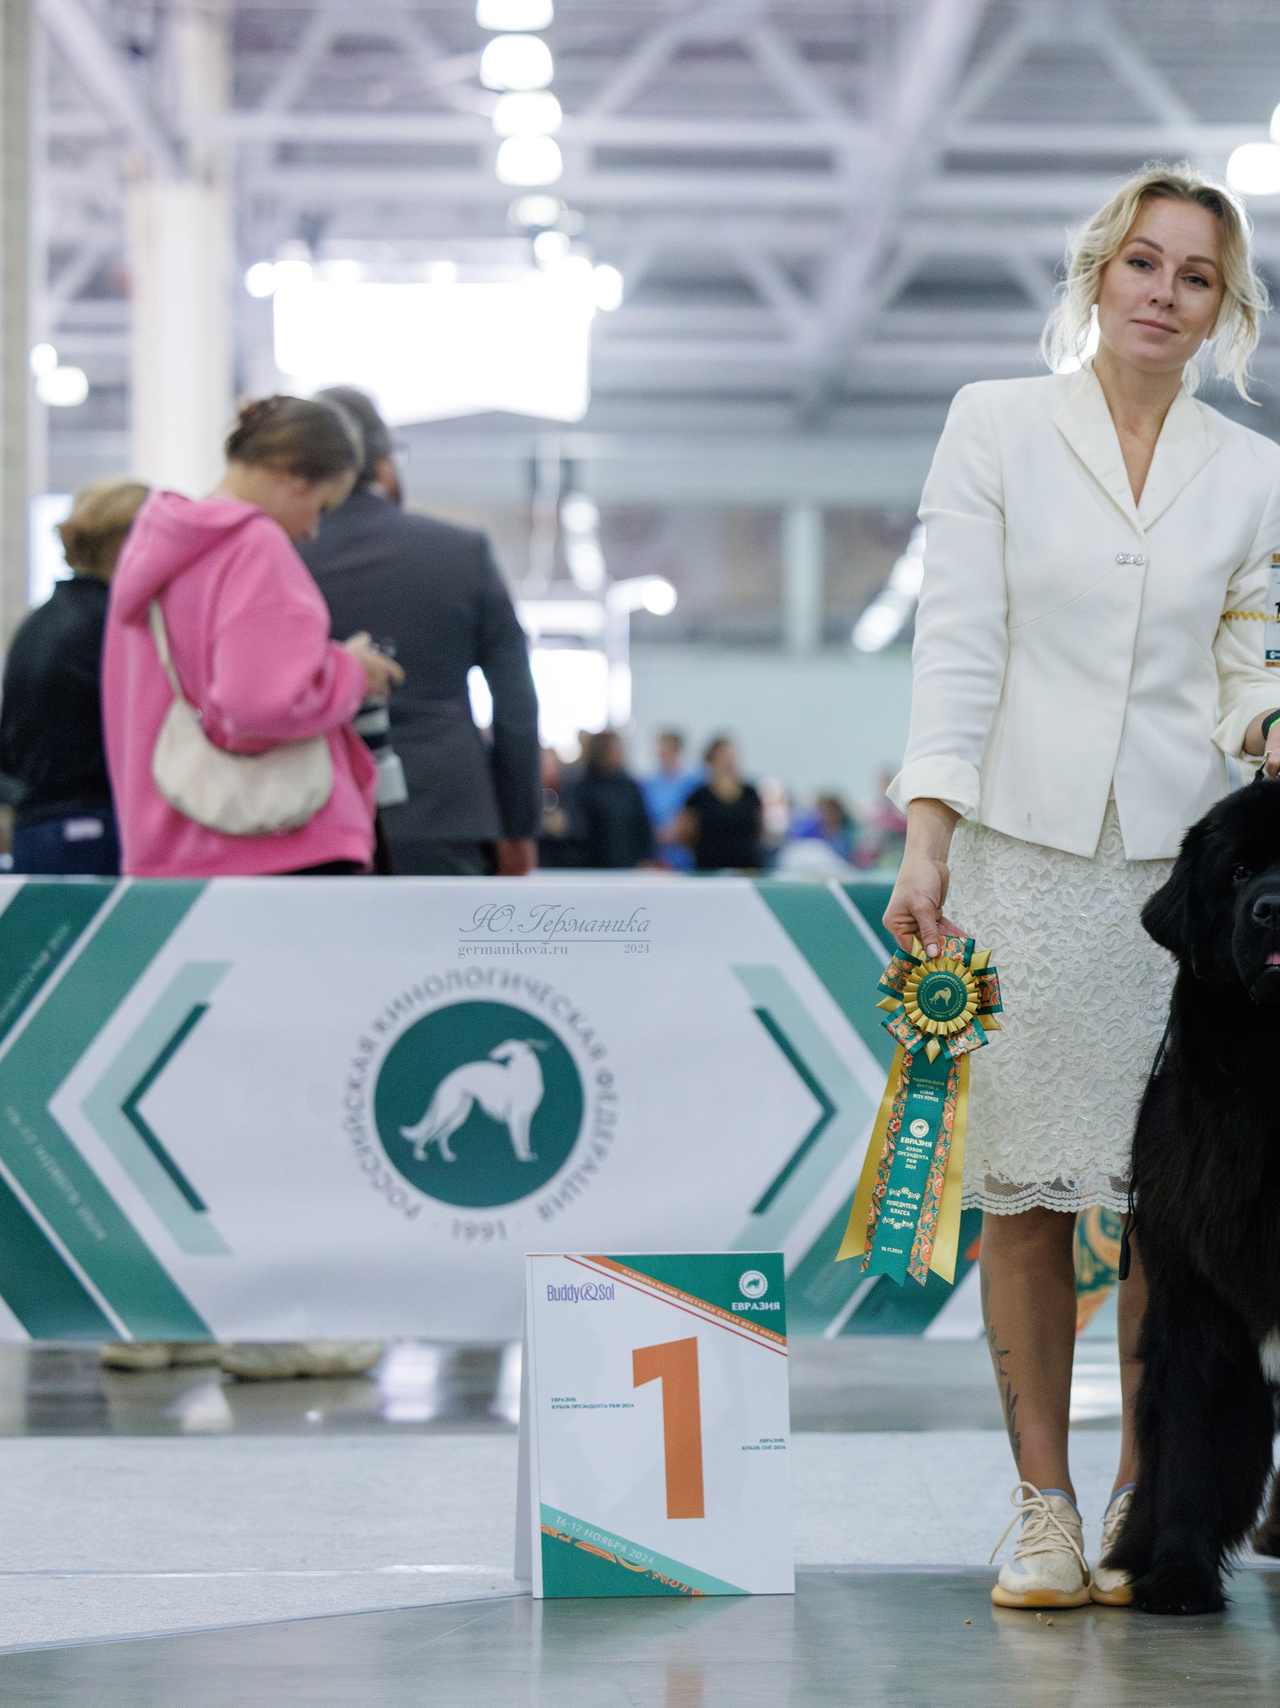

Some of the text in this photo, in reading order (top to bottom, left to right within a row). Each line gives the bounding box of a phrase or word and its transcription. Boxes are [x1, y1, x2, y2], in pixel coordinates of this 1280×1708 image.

[900, 1136, 933, 1148] ЕВРАЗИЯ
[897, 1150, 929, 1161] ПРЕЗИДЕНТА
[886, 1199, 918, 1210] ПОБЕДИТЕЛЬ
[889, 1207, 911, 1216] КЛАССА
[547, 1281, 615, 1304] Buddy&Sol
[621, 1268, 783, 1343] НАЦИОНАЛЬНЫЕ ВЫСТАВКИ СОБАК ВСЕХ ПОРОД
[731, 1301, 781, 1311] ЕВРАЗИЯ
[632, 1336, 705, 1519] 1
[555, 1515, 655, 1565] 16-17 НОЯБРЯ 2024
